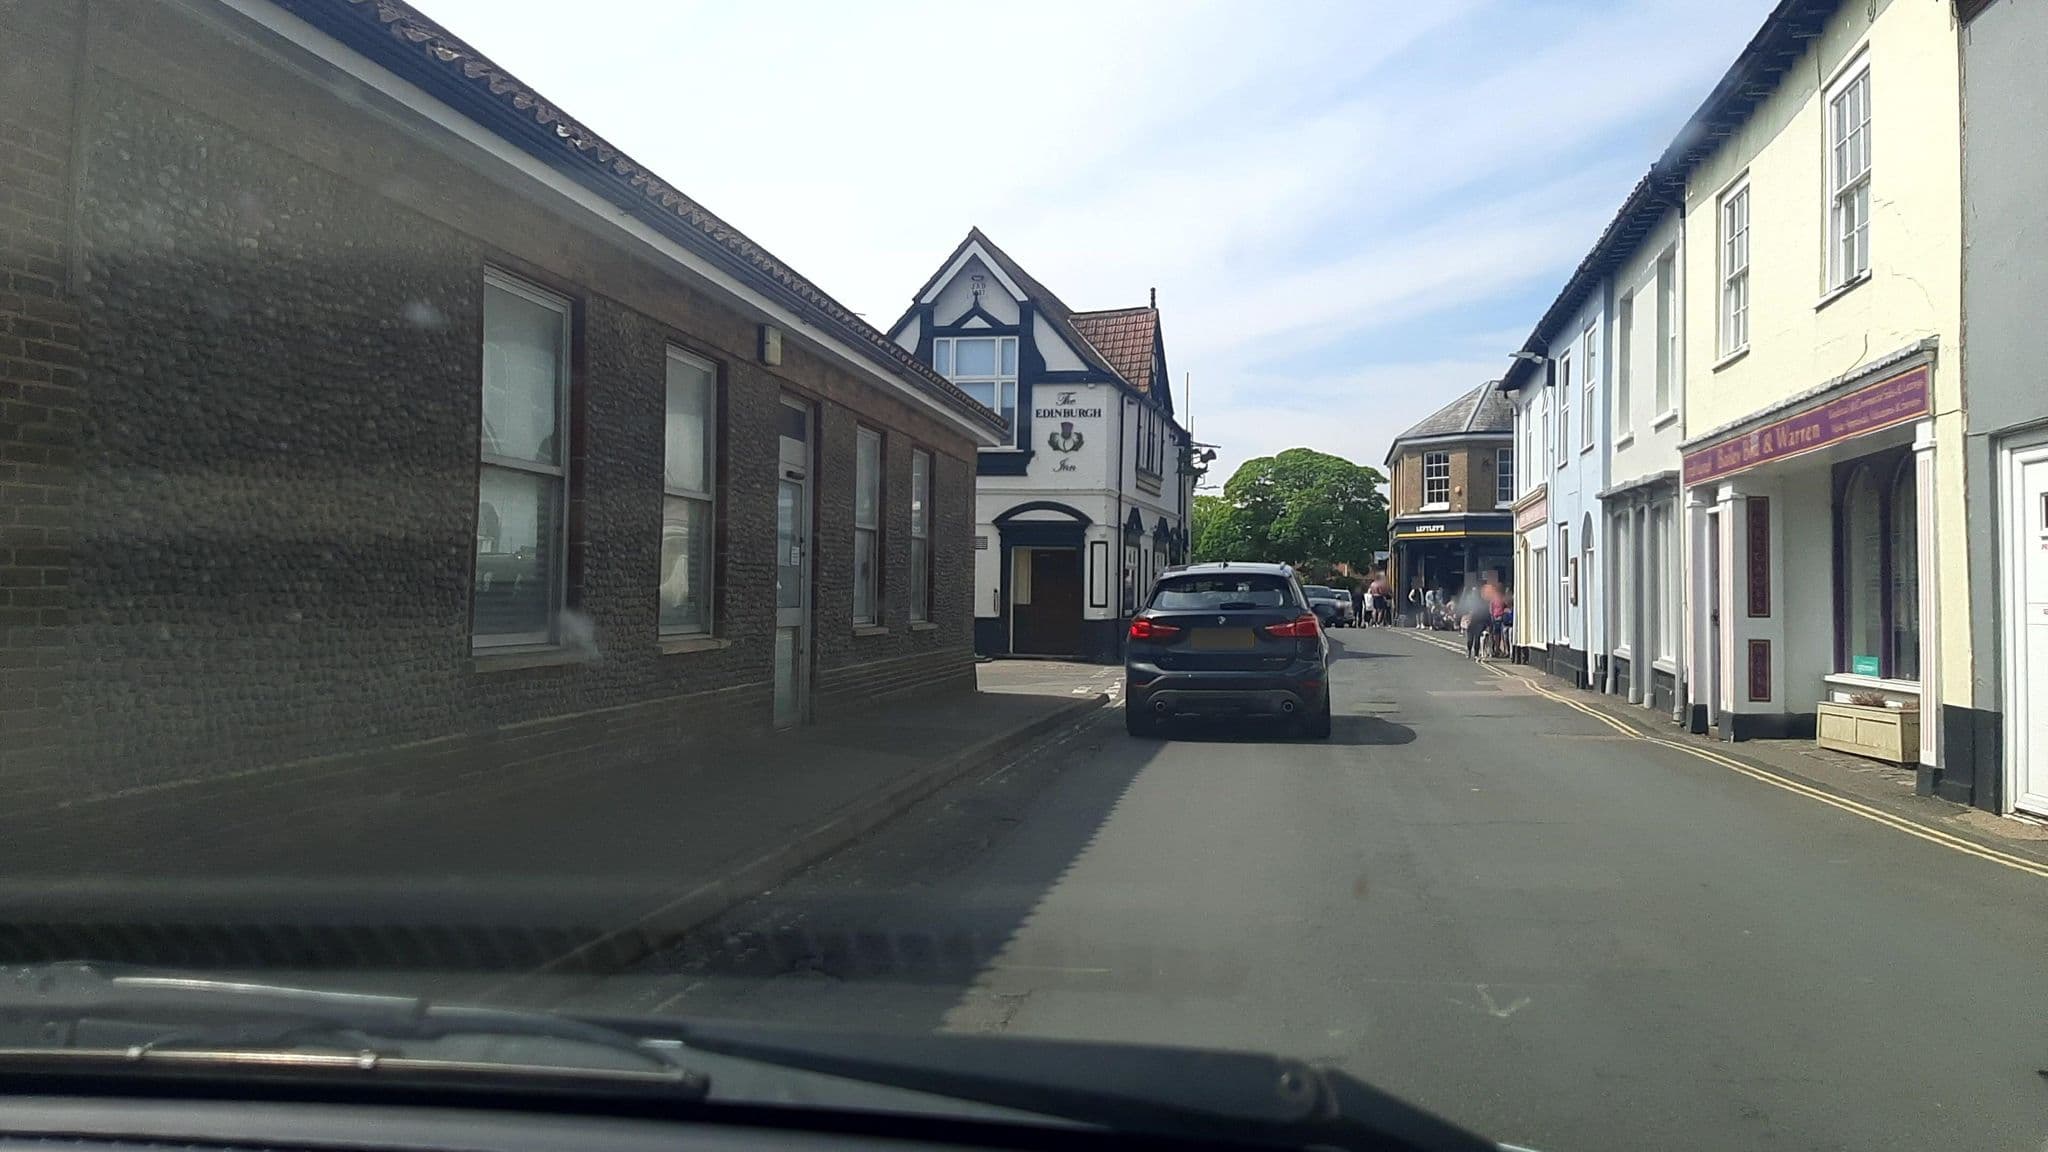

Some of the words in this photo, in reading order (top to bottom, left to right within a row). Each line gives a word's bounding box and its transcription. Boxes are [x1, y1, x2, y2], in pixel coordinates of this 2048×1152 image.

[1056, 391, 1077, 406] The
[1035, 408, 1102, 418] EDINBURGH
[1762, 431, 1774, 454] &
[1776, 424, 1820, 449] Warren
[1053, 457, 1076, 472] Inn
